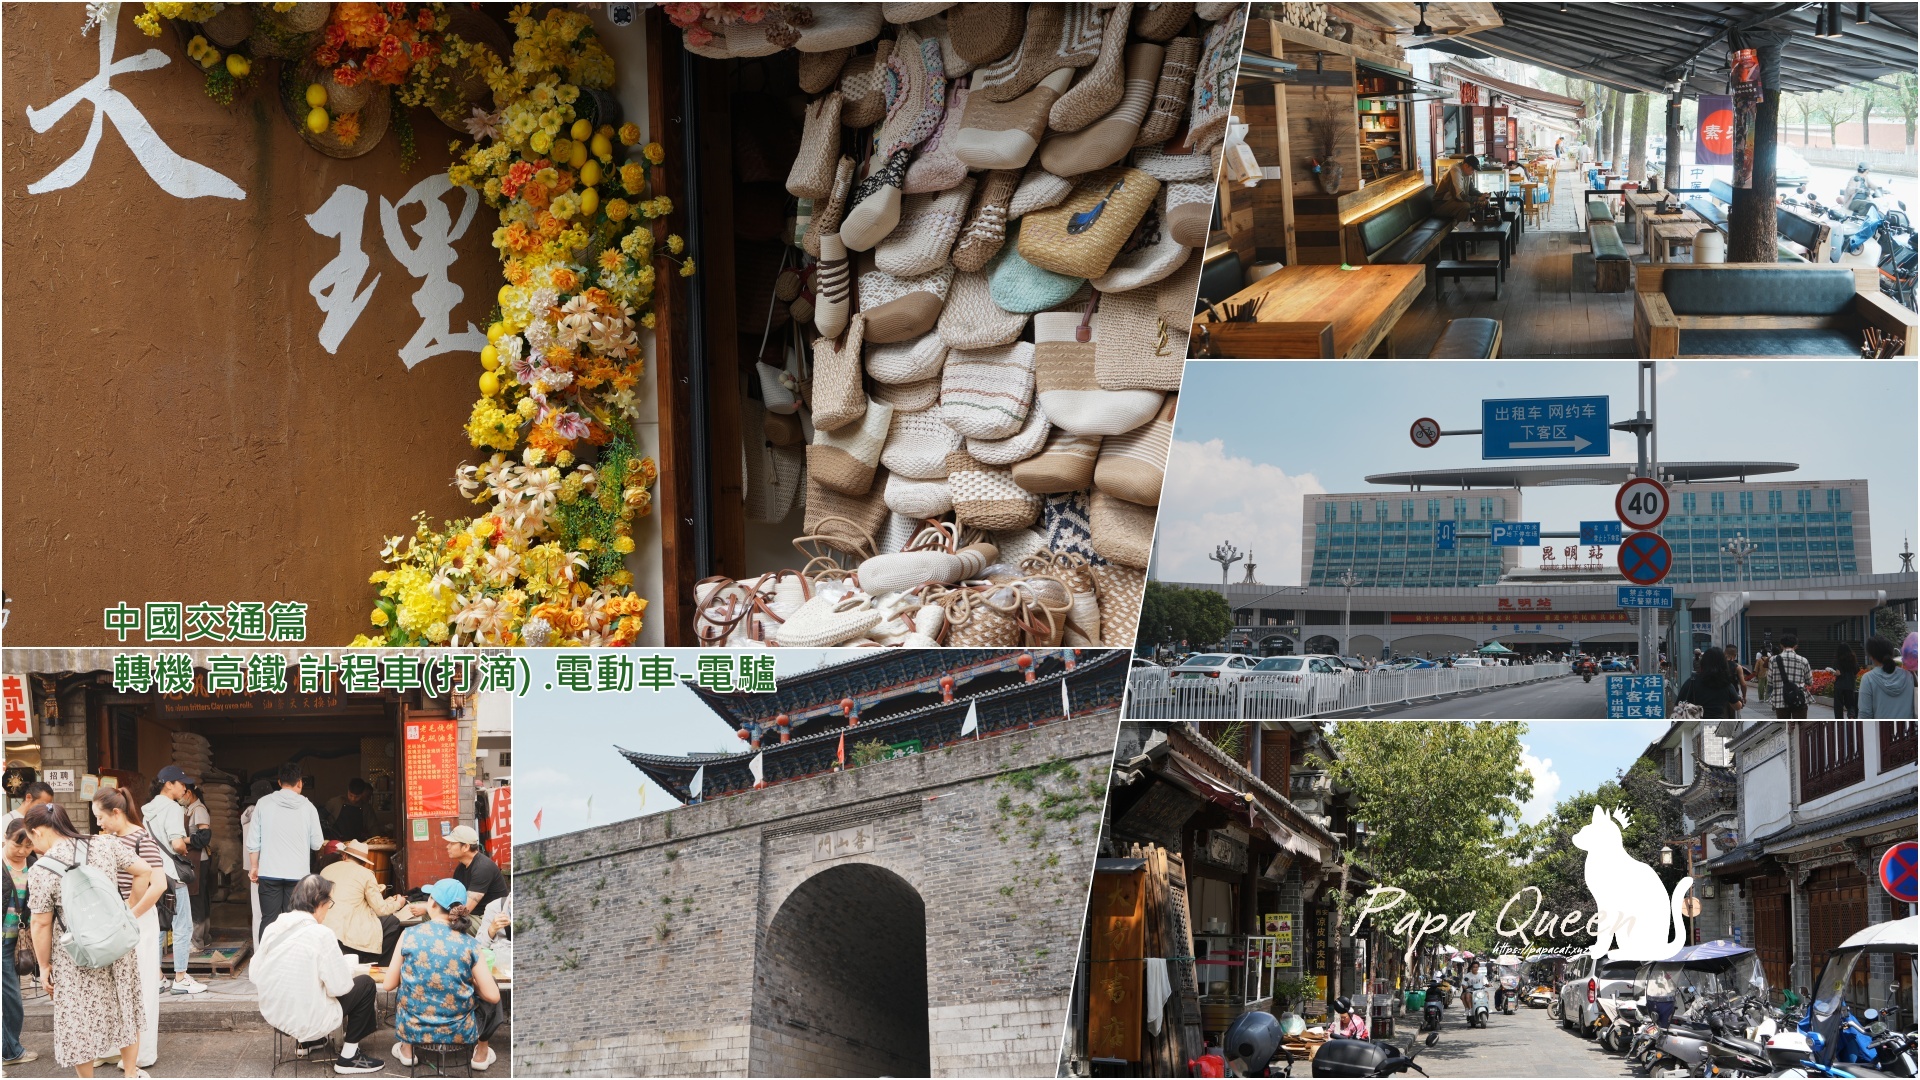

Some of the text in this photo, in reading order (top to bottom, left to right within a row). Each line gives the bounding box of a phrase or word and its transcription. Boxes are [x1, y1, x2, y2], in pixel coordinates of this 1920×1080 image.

[1495, 404, 1596, 421] 出租车 网约车
[1520, 425, 1567, 440] 下客区
[1628, 492, 1658, 515] 40
[1493, 527, 1506, 542] P
[1542, 545, 1604, 561] 昆明站
[1629, 589, 1660, 597] 禁止停车
[1498, 598, 1552, 607] 昆明站
[1621, 597, 1669, 606] 电子警察抓拍
[1626, 677, 1643, 717] 下客区
[1643, 676, 1662, 717] 往右转
[190, 703, 211, 712] fritters
[211, 702, 224, 712] Clay
[50, 771, 69, 780] 招聘
[1316, 917, 1326, 970] 凉皮肉夹馍
